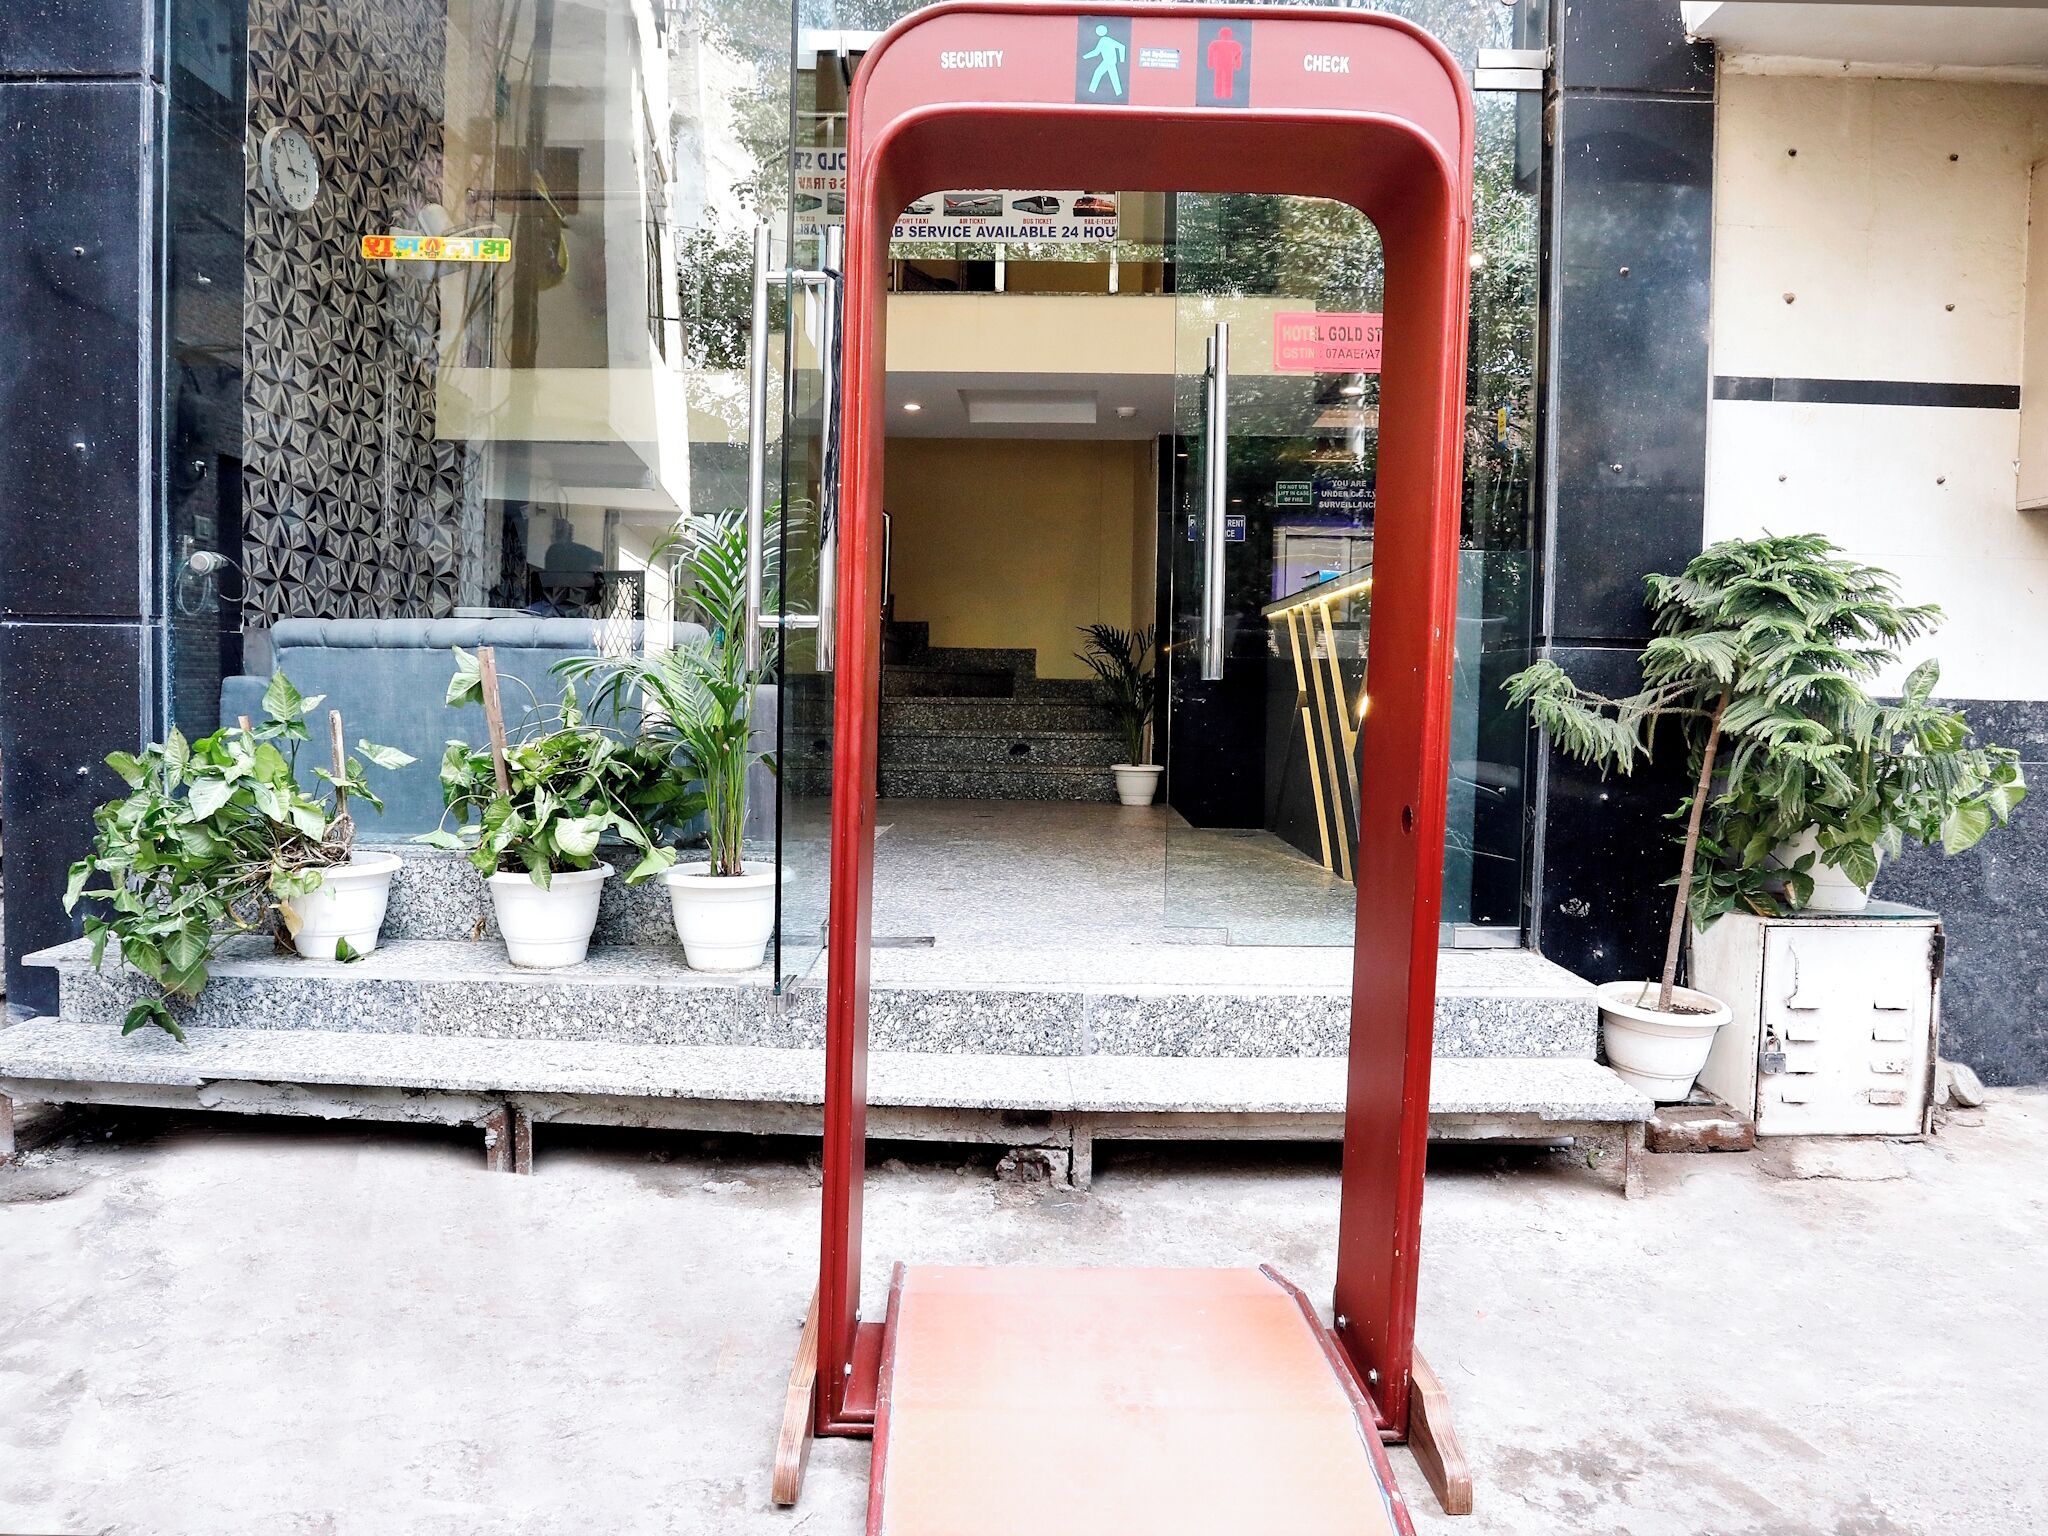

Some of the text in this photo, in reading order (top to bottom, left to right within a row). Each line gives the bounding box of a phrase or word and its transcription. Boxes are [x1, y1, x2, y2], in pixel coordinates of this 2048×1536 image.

[941, 51, 1003, 68] SECURITY
[1303, 54, 1350, 73] CHECK
[908, 225, 972, 238] SERVICE
[975, 225, 1058, 238] AVAILABLE
[1061, 226, 1079, 238] 24
[1284, 325, 1325, 341] HOTEL
[1328, 326, 1363, 341] GOLD
[1284, 347, 1316, 359] GSTIN
[1321, 490, 1349, 498] UNDER
[1227, 519, 1244, 527] RENT
